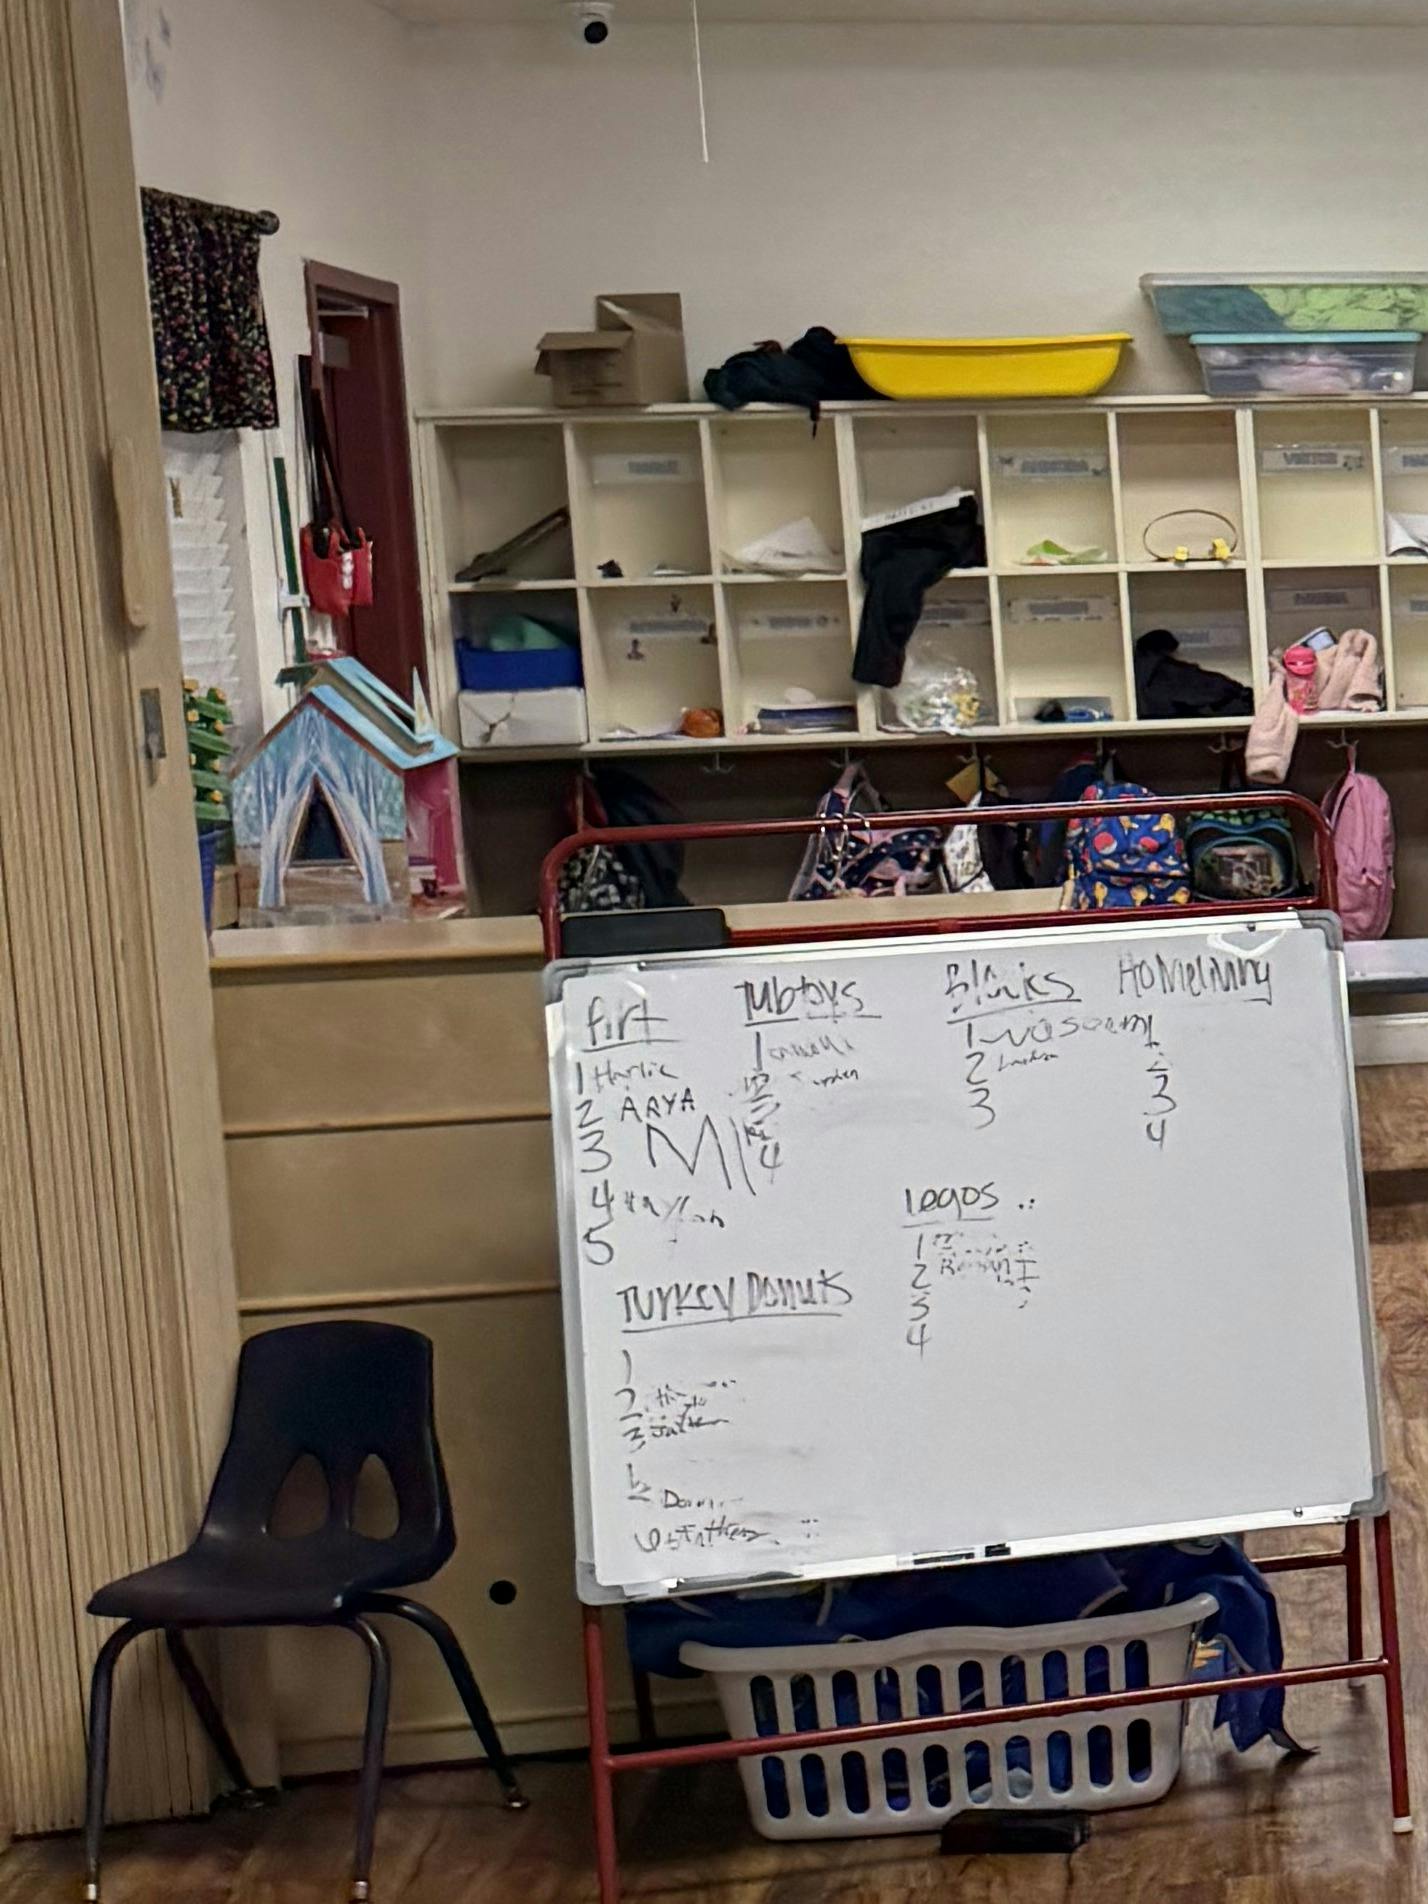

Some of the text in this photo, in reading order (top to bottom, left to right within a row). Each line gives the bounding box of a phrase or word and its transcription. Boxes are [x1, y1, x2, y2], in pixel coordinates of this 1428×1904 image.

[575, 1062, 583, 1095] 1
[965, 1051, 988, 1085] 2
[576, 1088, 696, 1129] 2 ARYA
[969, 1087, 996, 1130] 3
[580, 1130, 612, 1174] 3
[1145, 1119, 1166, 1150] 4
[592, 1179, 614, 1220] 4
[583, 1223, 615, 1266] 5
[911, 1264, 932, 1289] 2
[906, 1322, 932, 1361] 4
